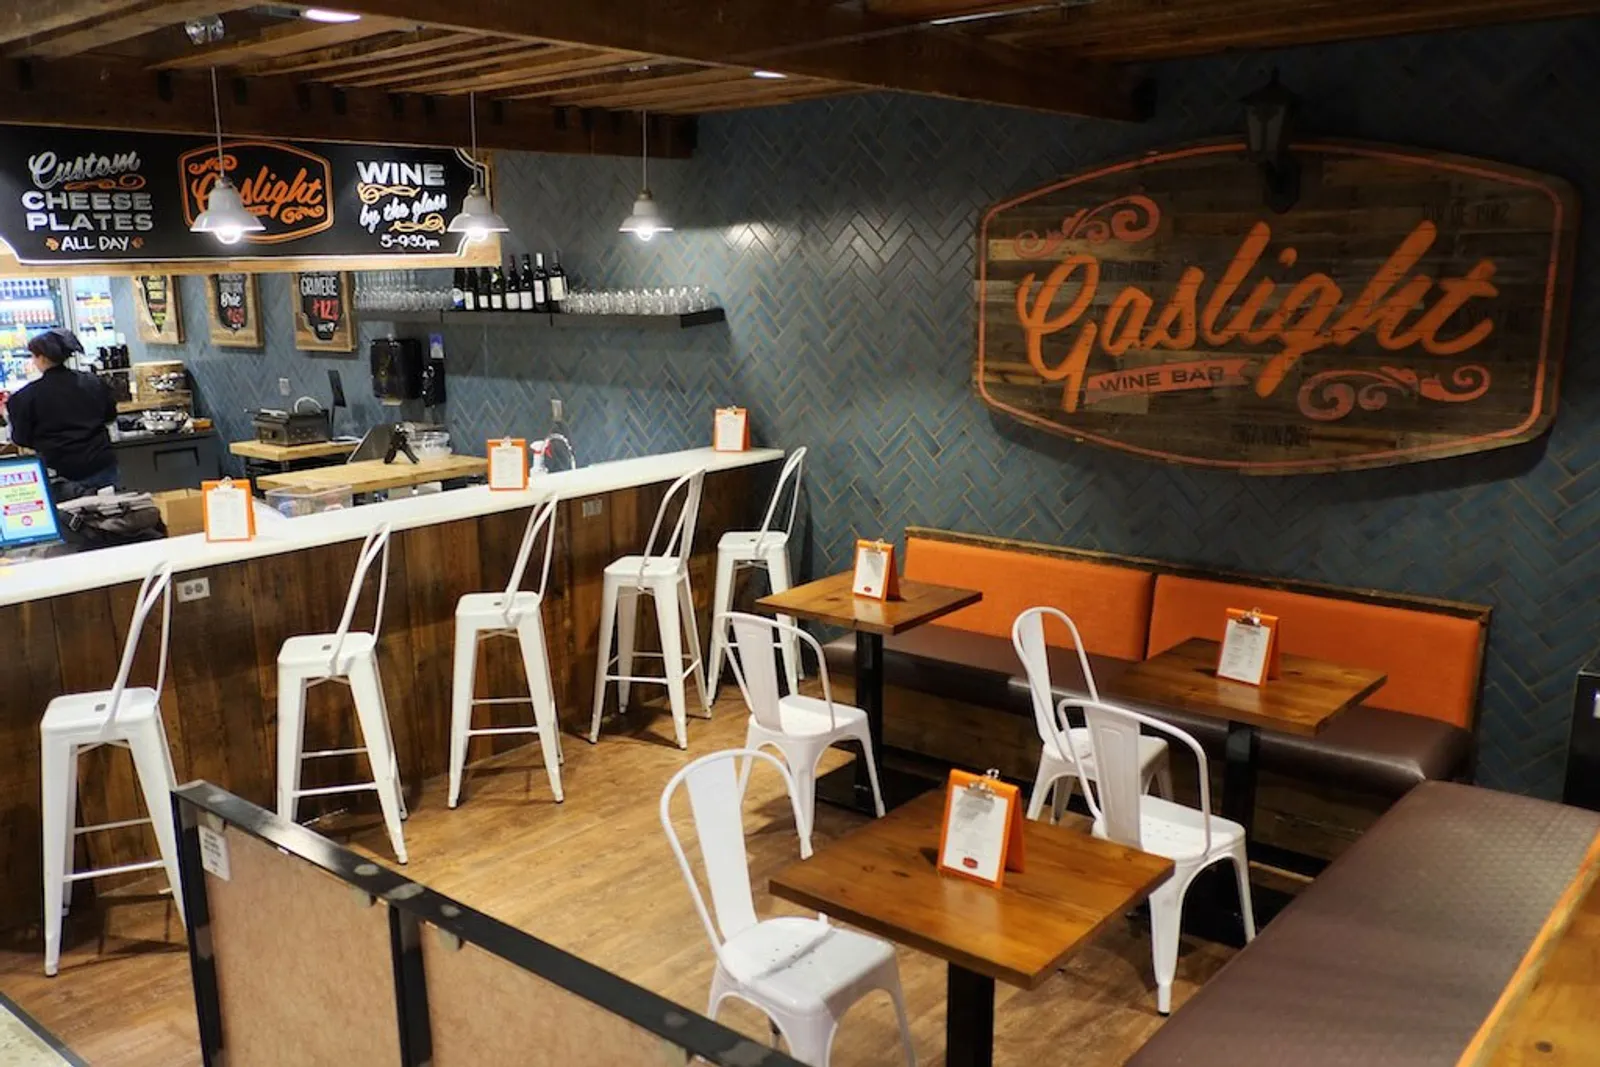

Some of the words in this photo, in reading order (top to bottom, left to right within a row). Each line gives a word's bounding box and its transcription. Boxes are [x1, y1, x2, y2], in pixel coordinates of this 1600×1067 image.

[28, 151, 141, 190] Custom
[356, 161, 446, 186] WINE
[21, 191, 153, 211] CHEESE
[359, 203, 381, 233] by
[383, 197, 409, 222] the
[412, 191, 448, 223] glass
[26, 212, 154, 231] PLATES
[61, 236, 96, 251] ALL
[99, 236, 129, 251] DAY
[1016, 219, 1500, 413] Gaslight
[1099, 371, 1161, 392] WINE
[1170, 366, 1225, 383] BAR
